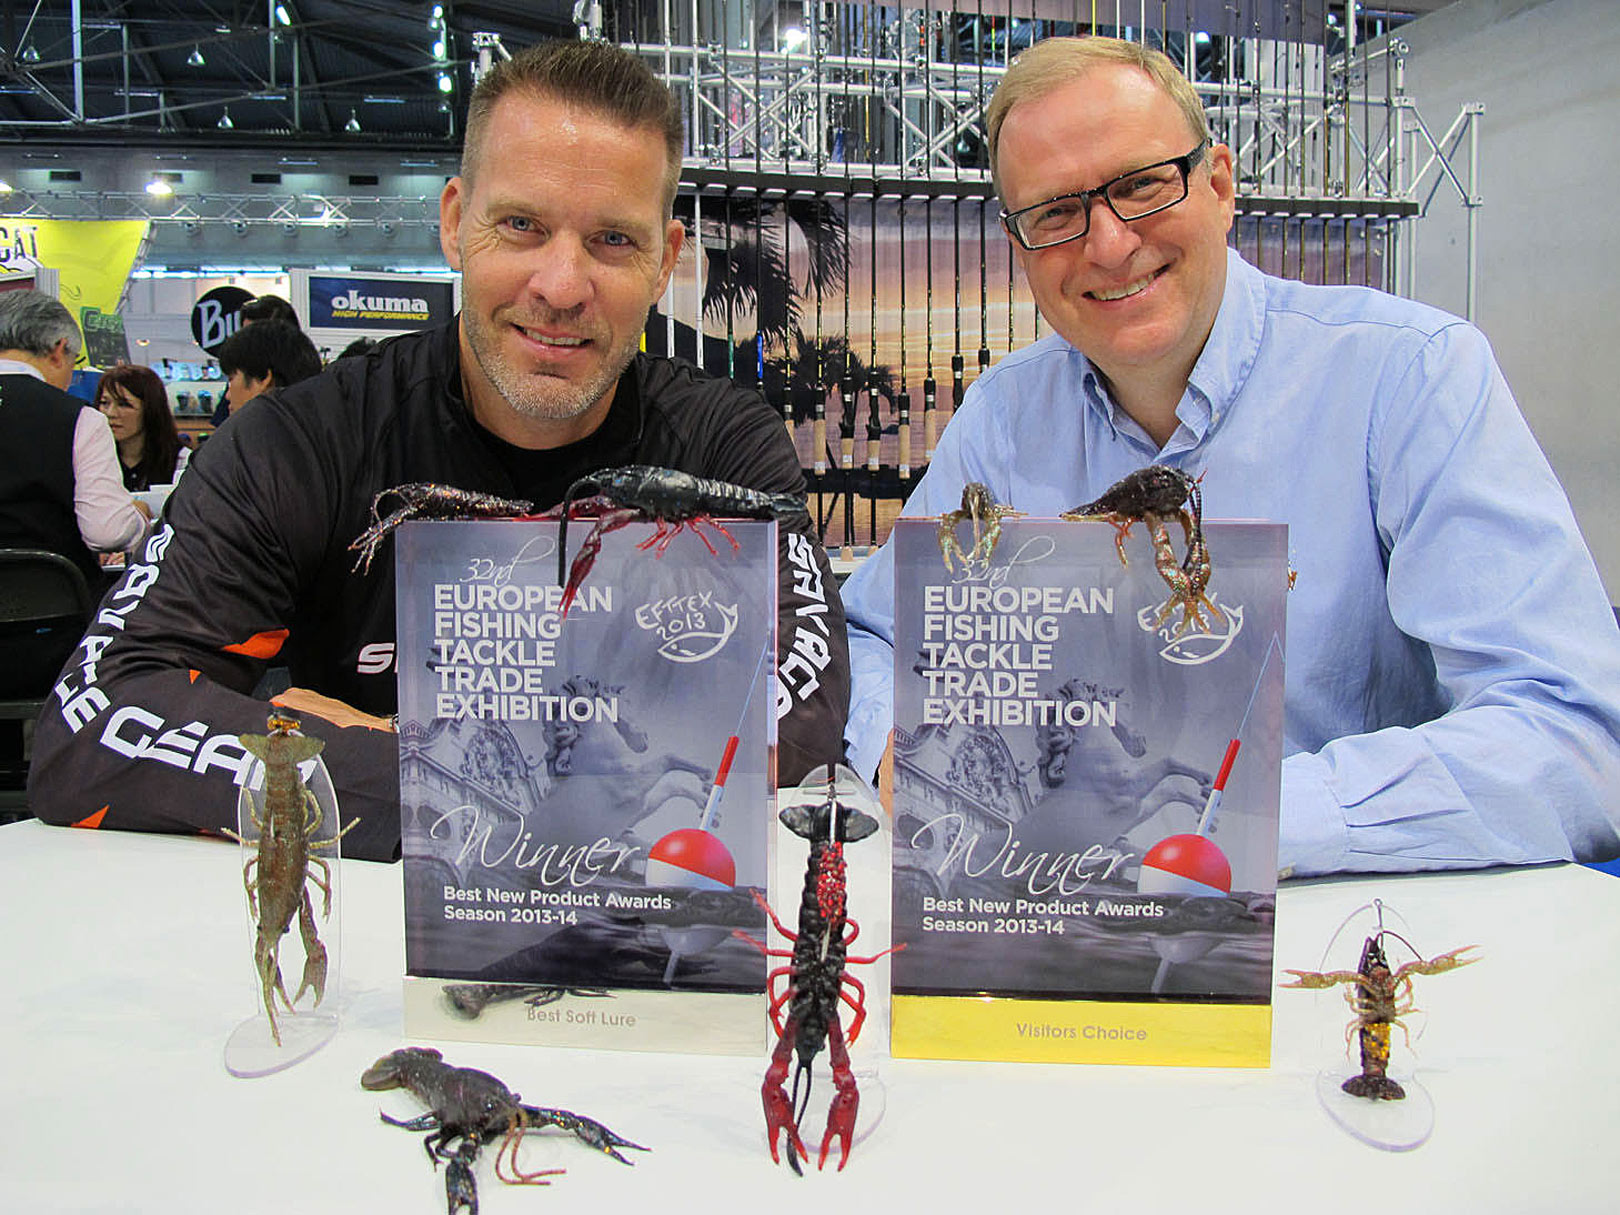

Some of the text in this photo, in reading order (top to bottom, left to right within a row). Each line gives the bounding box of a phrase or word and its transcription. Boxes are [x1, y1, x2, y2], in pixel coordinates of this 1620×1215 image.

[0, 226, 38, 263] CAT
[331, 289, 429, 313] okuma
[197, 300, 242, 349] Bu
[459, 536, 555, 587] 32nd
[434, 584, 613, 612] EUROPEAN
[635, 590, 713, 630] EFTTEX
[924, 585, 1114, 614] EUROPEAN
[434, 612, 562, 639] FISHING
[656, 612, 706, 641] 2013
[923, 614, 1060, 641] FISHING
[434, 639, 556, 667] TACKLE
[922, 642, 1053, 670] TACKLE
[434, 666, 543, 694] TRADE
[922, 670, 1039, 698] TRADE
[436, 693, 619, 722] EXHIBITION
[923, 698, 1117, 727] EXHIBITION
[100, 706, 318, 791] GEA
[430, 805, 641, 887] Winner
[911, 813, 1135, 896] Winner
[443, 886, 672, 910] Best New Product Awards
[923, 897, 1164, 918] Best New Product Awards
[443, 905, 578, 925] Season 2013-14
[923, 917, 1065, 935] Season 2013-14
[527, 1006, 561, 1022] Best
[601, 1011, 636, 1027] Lure
[1016, 1022, 1147, 1041] Visitors Choice
